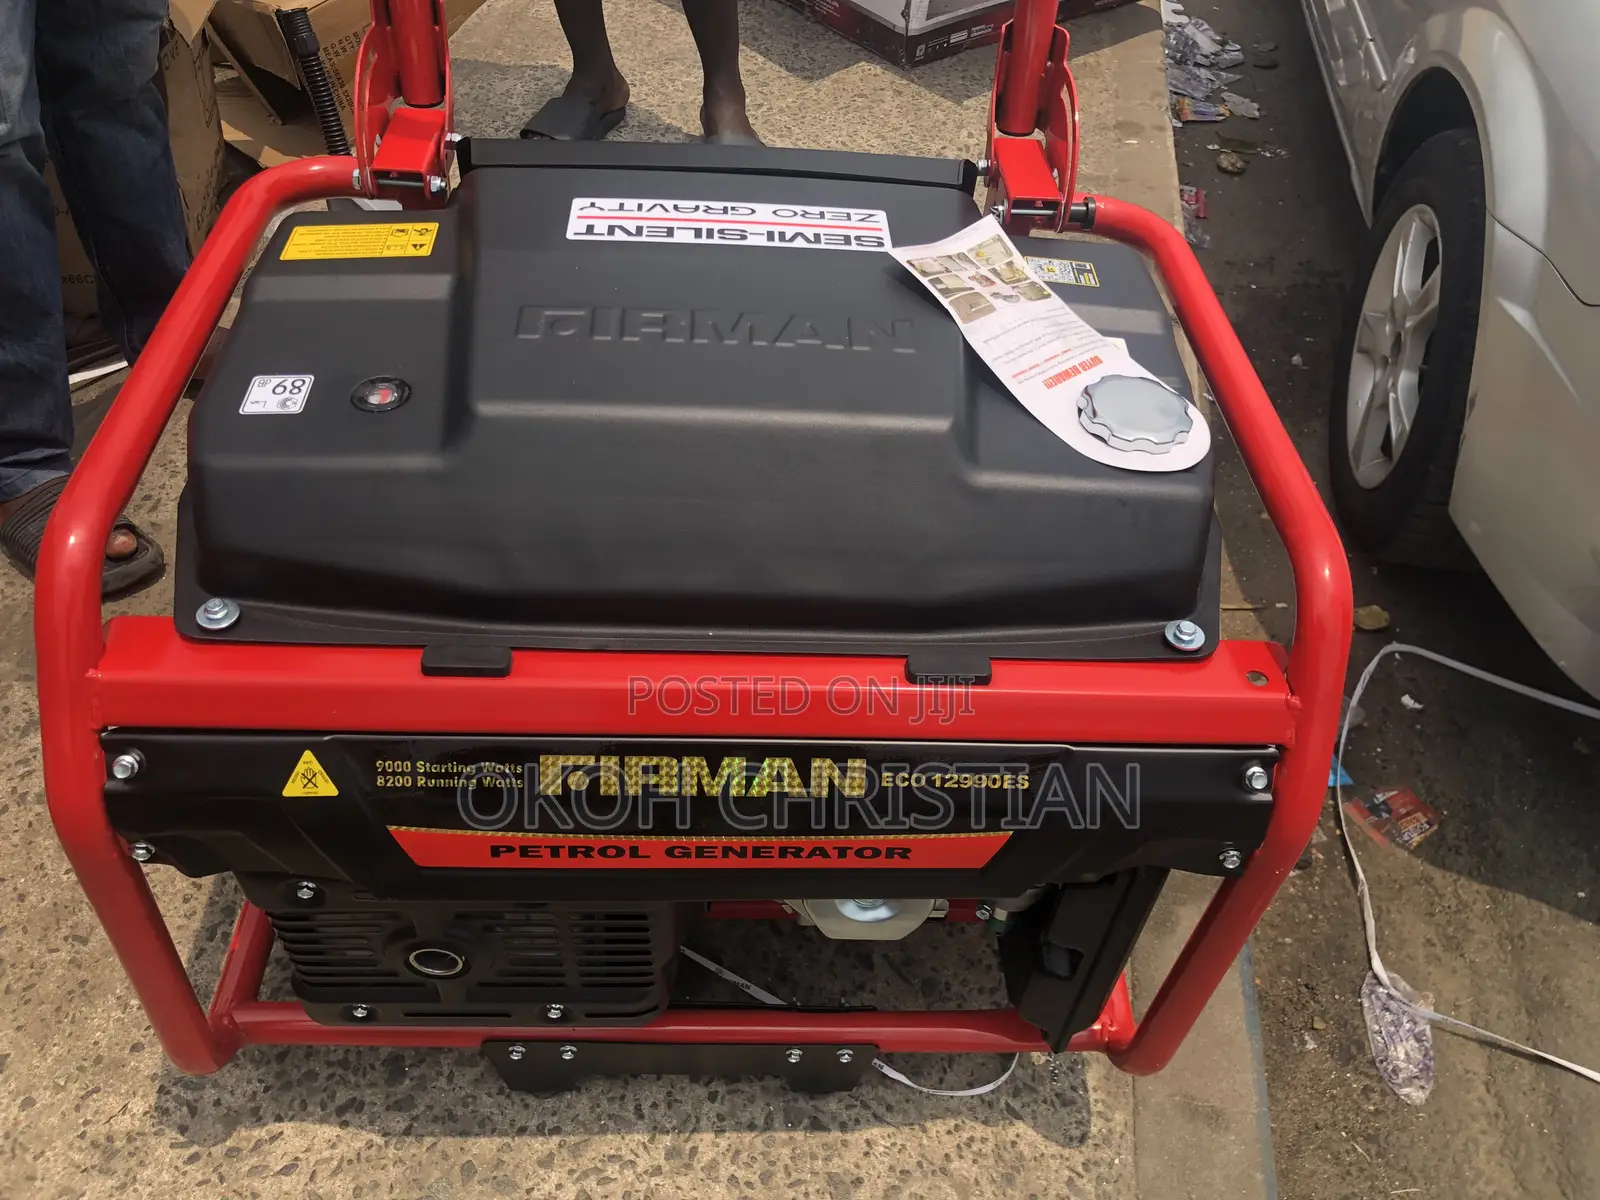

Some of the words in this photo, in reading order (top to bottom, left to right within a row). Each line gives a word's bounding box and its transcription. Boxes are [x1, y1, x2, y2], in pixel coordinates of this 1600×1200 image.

[333, 89, 346, 111] CHINA
[579, 202, 757, 217] GRAVITY
[772, 208, 881, 223] ZERO
[573, 224, 886, 248] SEMI-SILENT
[515, 305, 916, 353] FIRMAN
[1079, 355, 1104, 372] BUYER
[257, 378, 272, 388] dB
[272, 378, 306, 396] 89
[376, 761, 412, 774] 9000
[416, 760, 477, 776] Starting
[481, 761, 523, 774] Watts
[540, 755, 867, 797] FIRMAN
[376, 775, 412, 788] 8200
[416, 776, 477, 790] Running
[482, 776, 524, 789] Watts
[881, 771, 926, 788] ECO
[931, 773, 1030, 790] 12990ES
[489, 844, 652, 859] PETROL
[664, 845, 913, 860] GENERATOR
